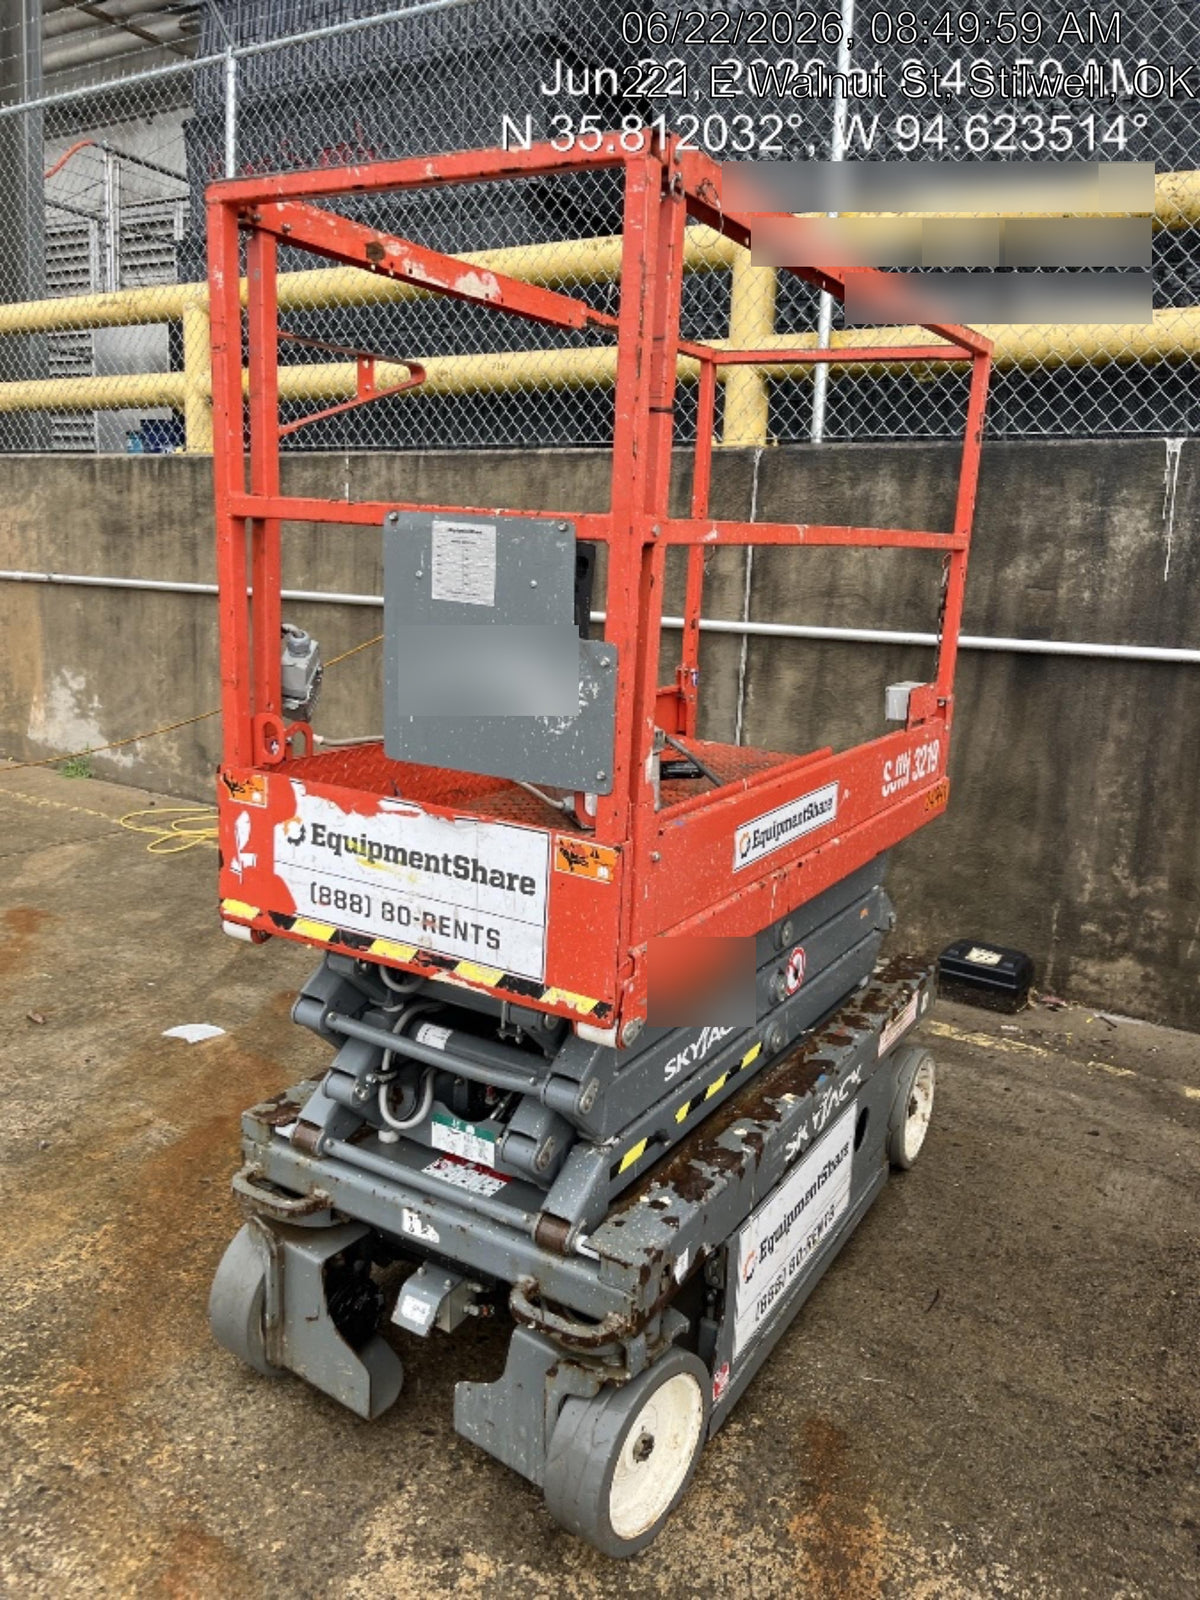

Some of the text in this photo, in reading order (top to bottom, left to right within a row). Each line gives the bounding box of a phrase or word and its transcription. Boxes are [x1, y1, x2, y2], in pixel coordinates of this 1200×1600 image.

[911, 739, 940, 782] 3219
[752, 796, 834, 849] EquipmentShare
[310, 822, 537, 896] EquipmentShare
[309, 881, 501, 950] (888) 80-RENTS
[759, 1141, 850, 1264] EquipmentShare
